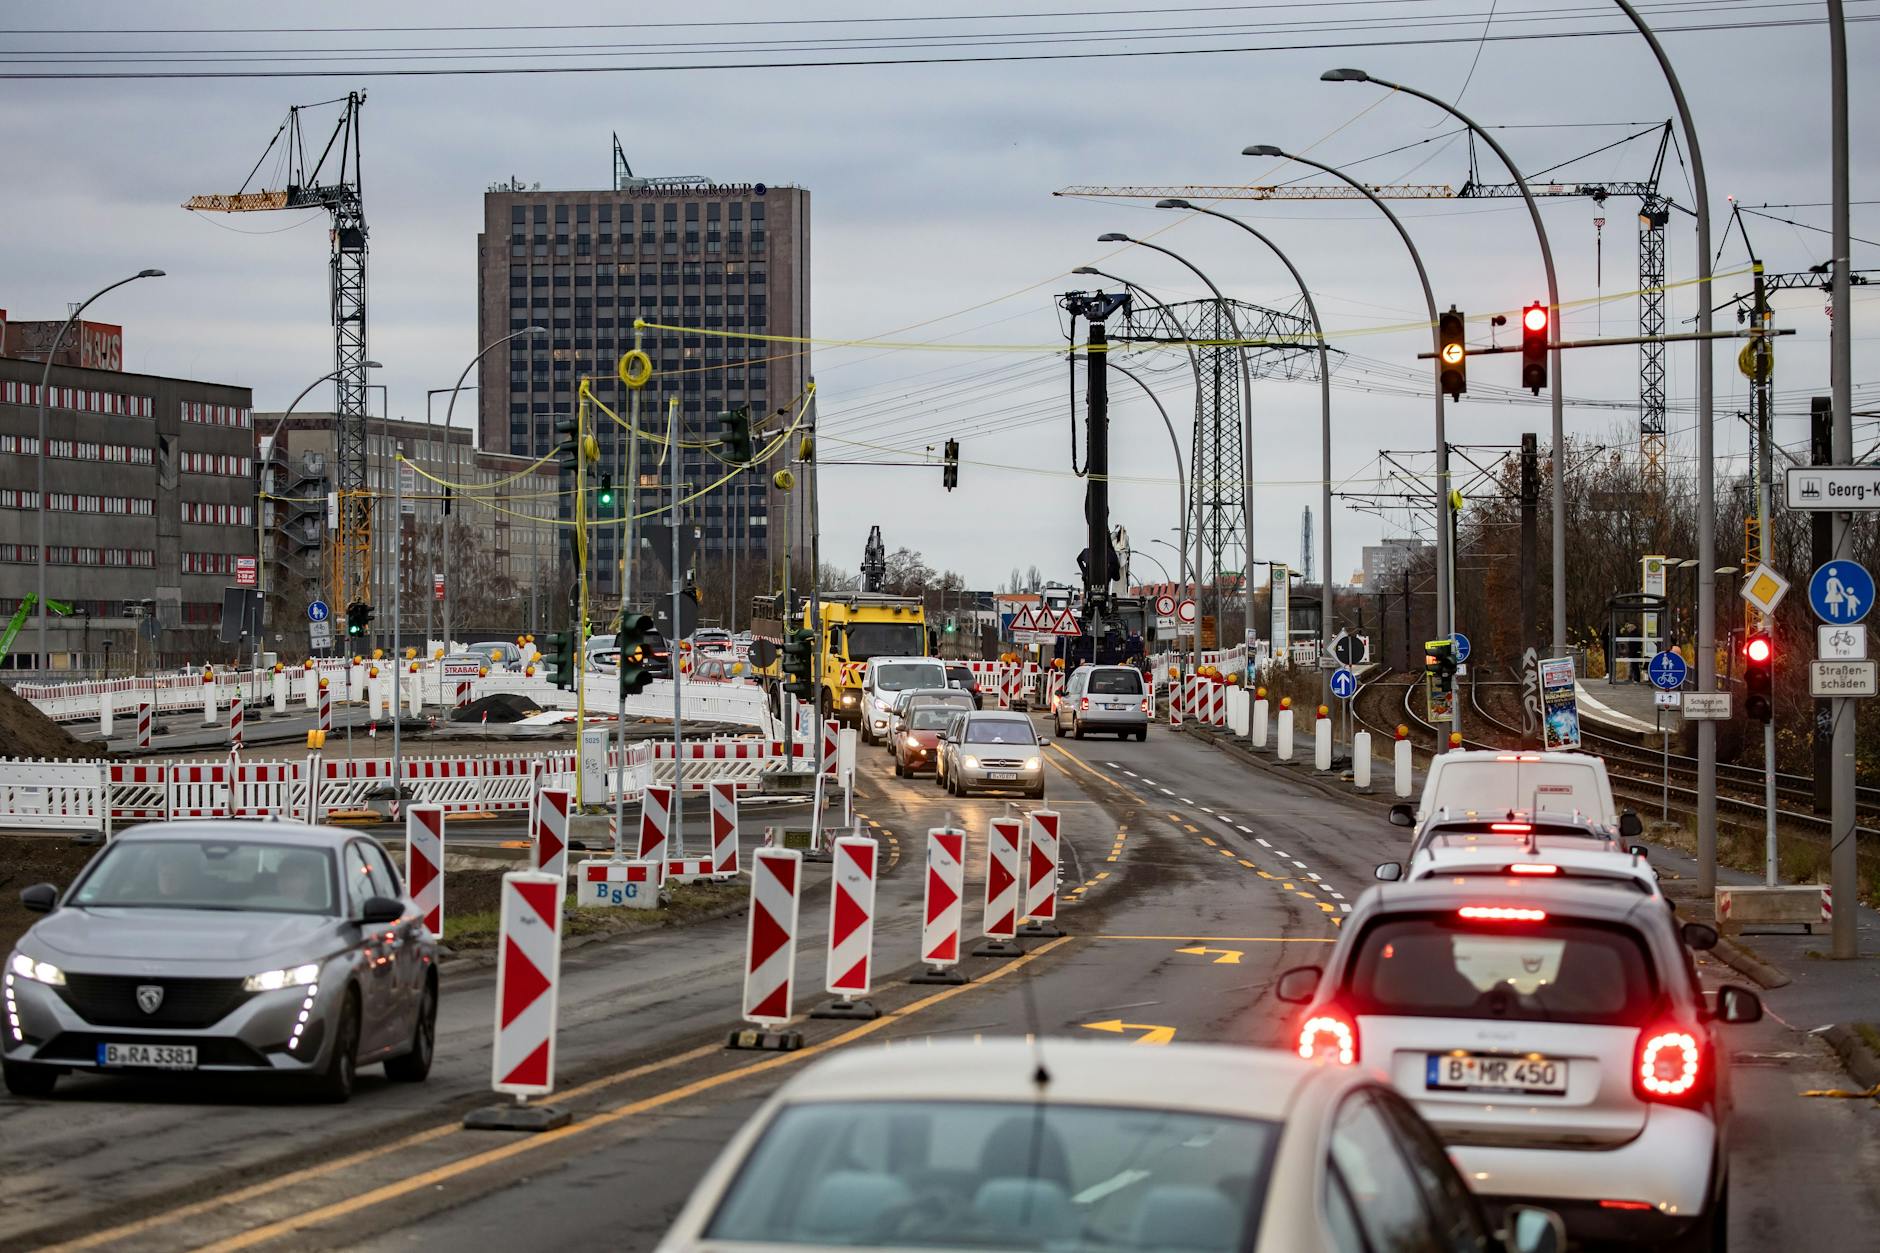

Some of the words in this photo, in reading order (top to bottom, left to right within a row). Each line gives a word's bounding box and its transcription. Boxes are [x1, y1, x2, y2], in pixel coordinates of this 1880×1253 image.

[629, 184, 690, 197] COMER
[695, 183, 752, 197] GROUP
[1828, 481, 1880, 501] Georg-K
[1836, 648, 1850, 656] frei
[445, 666, 479, 674] STRABAG
[1819, 666, 1868, 676] Straßen-
[108, 1046, 118, 1061] B
[129, 1047, 151, 1063] RA
[154, 1048, 193, 1065] 3381
[1449, 1060, 1462, 1081] B
[1514, 1063, 1556, 1085] 450
